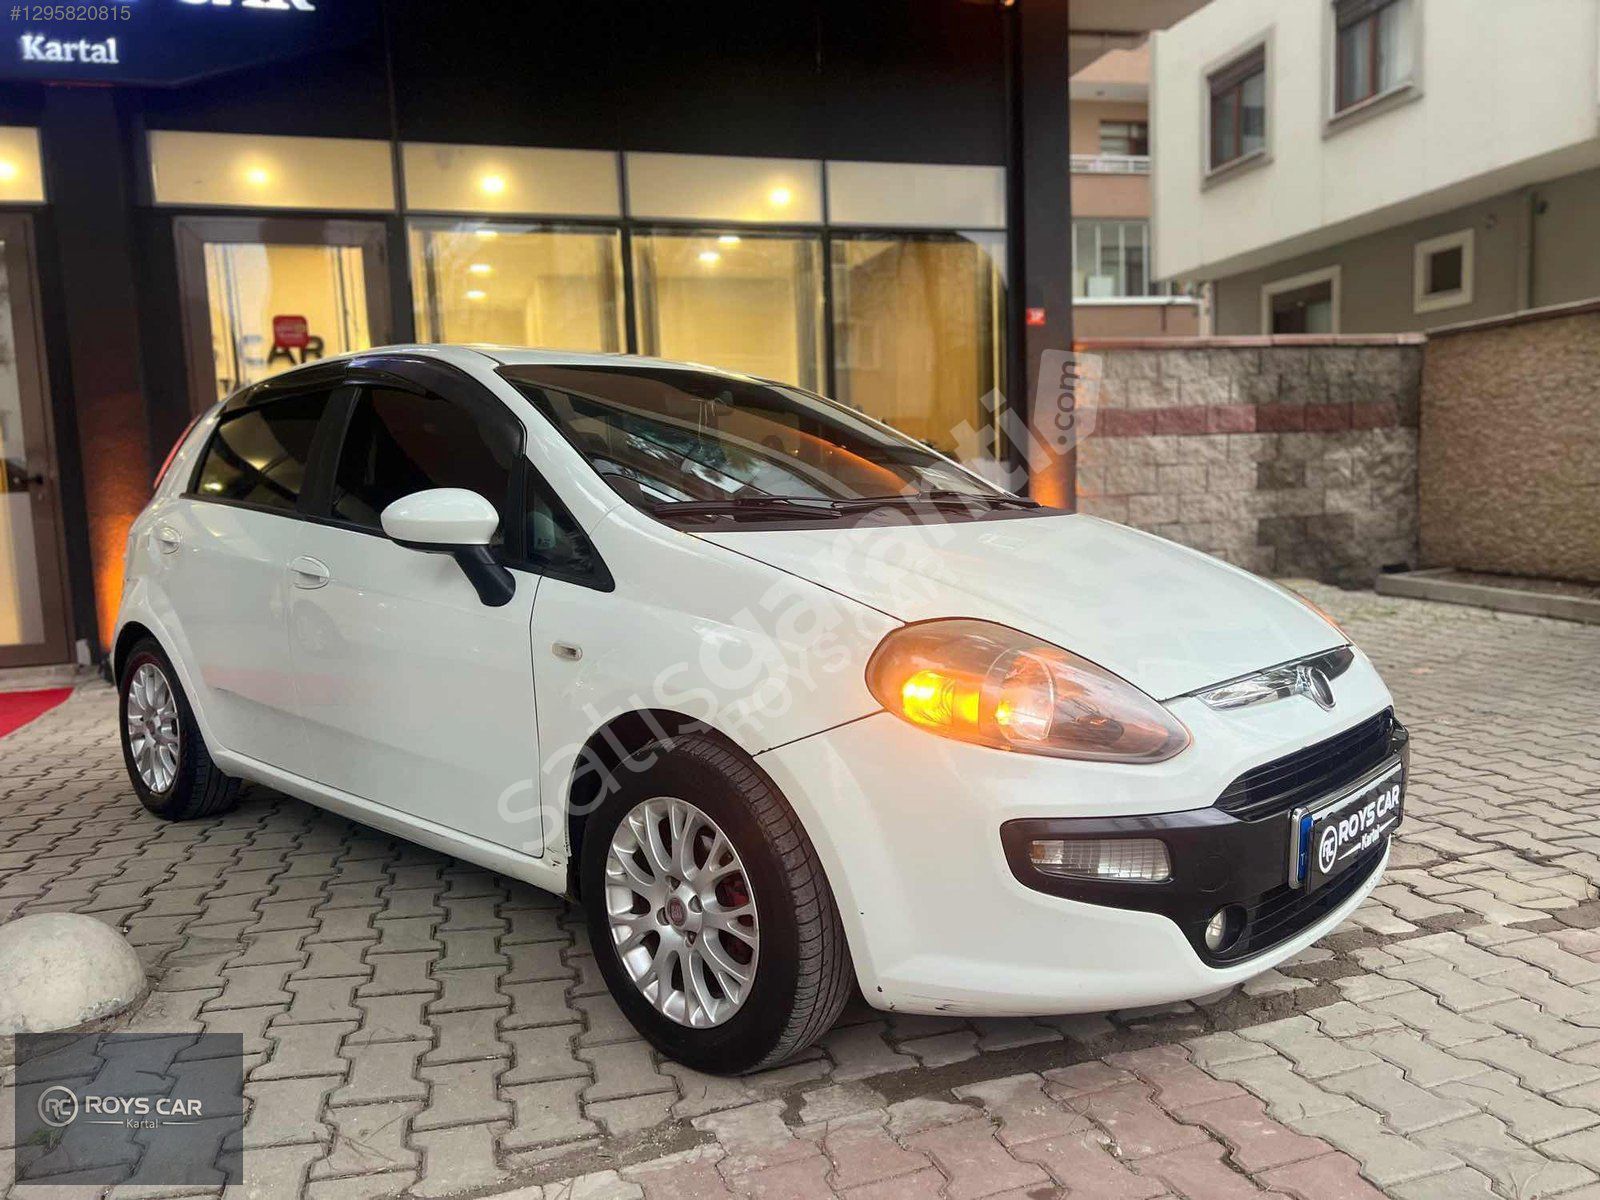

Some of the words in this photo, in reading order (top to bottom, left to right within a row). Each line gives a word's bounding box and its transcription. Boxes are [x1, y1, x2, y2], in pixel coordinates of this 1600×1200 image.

[20, 33, 119, 64] Kartal
[1339, 801, 1376, 846] ROYS
[1376, 784, 1400, 818] CAR
